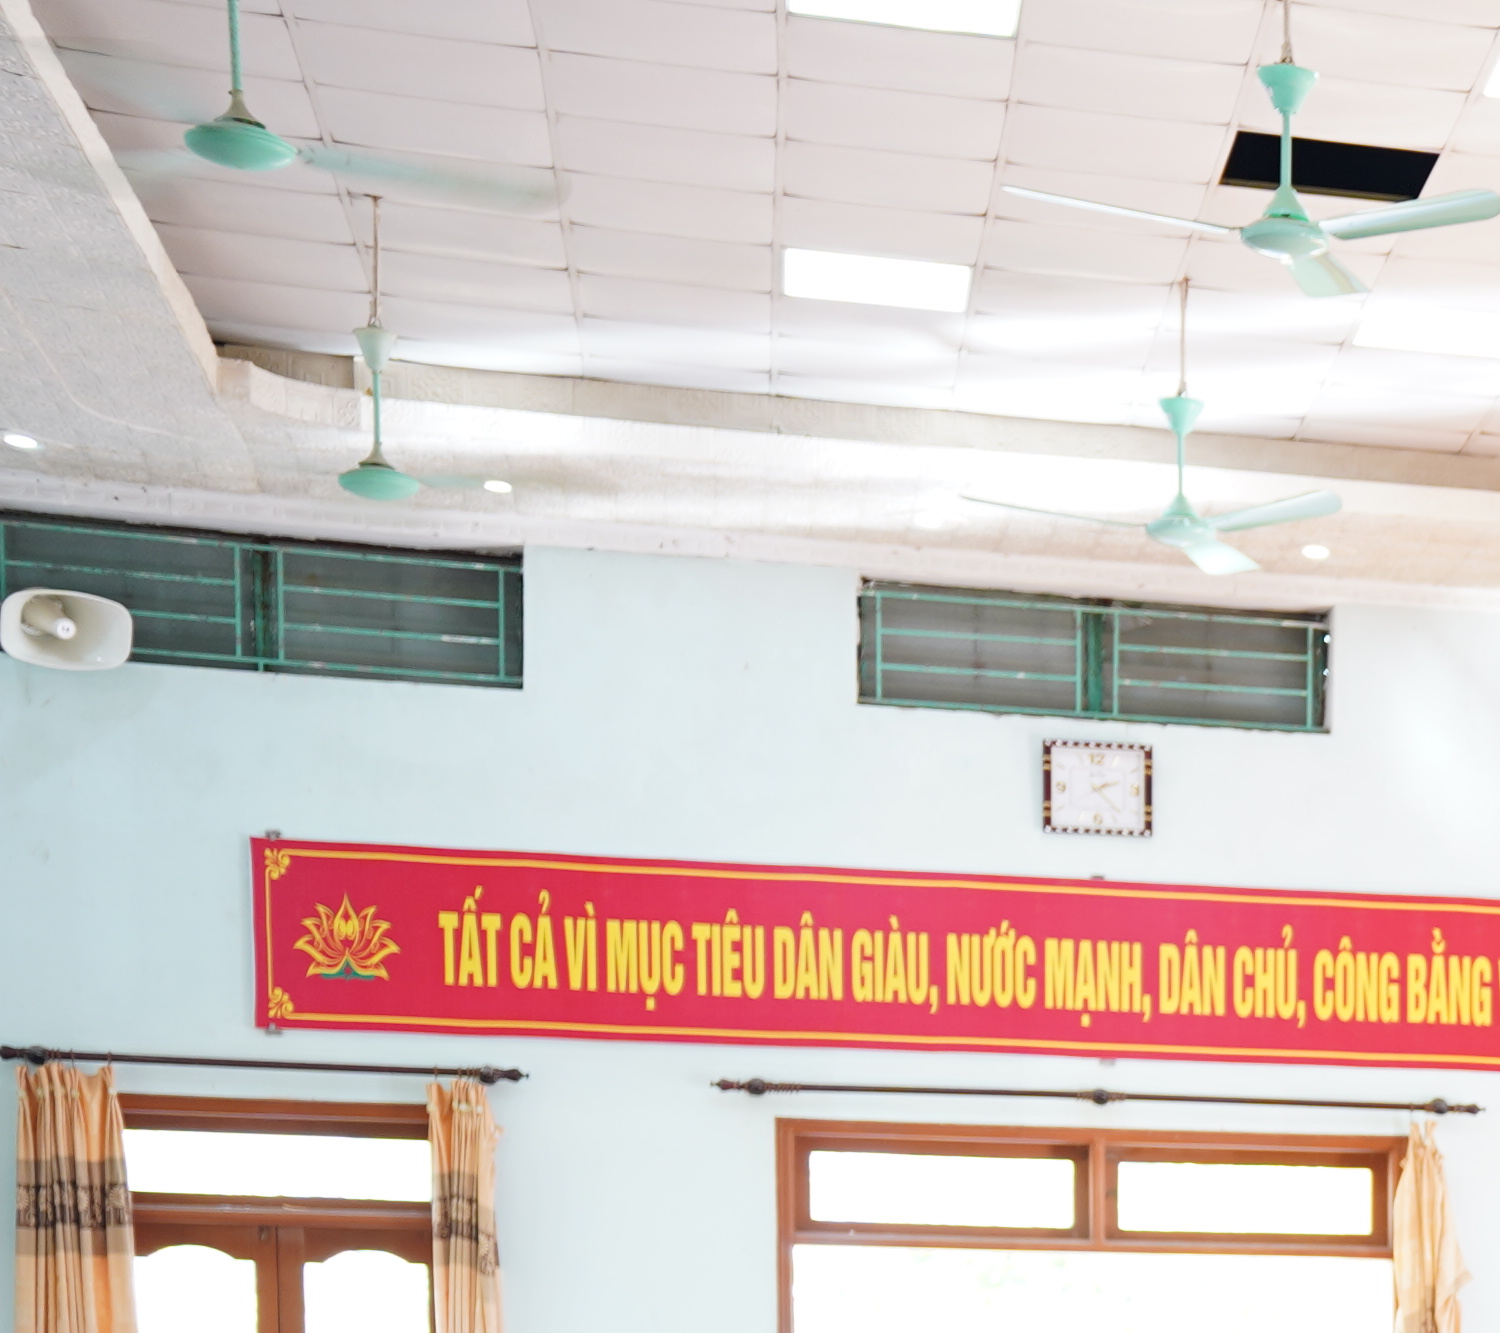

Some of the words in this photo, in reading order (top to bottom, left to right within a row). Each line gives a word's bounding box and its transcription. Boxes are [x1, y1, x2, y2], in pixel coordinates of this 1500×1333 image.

[1088, 753, 1105, 765] 12
[438, 885, 502, 988] TẤT
[509, 889, 559, 990] CẢ
[563, 901, 598, 992] VÌ
[605, 918, 685, 1011] MỤC
[691, 908, 766, 1000] TIÊU
[772, 910, 845, 1001] DÂN
[850, 914, 940, 1015] GIÀU,
[945, 919, 1038, 1010] NƯỚC
[1043, 937, 1153, 1028] MẠNH,
[1158, 928, 1227, 1017] DÂN
[1232, 924, 1307, 1029] CHỦ,
[1312, 935, 1401, 1024] CÔNG
[1406, 927, 1493, 1028] BẰNG
